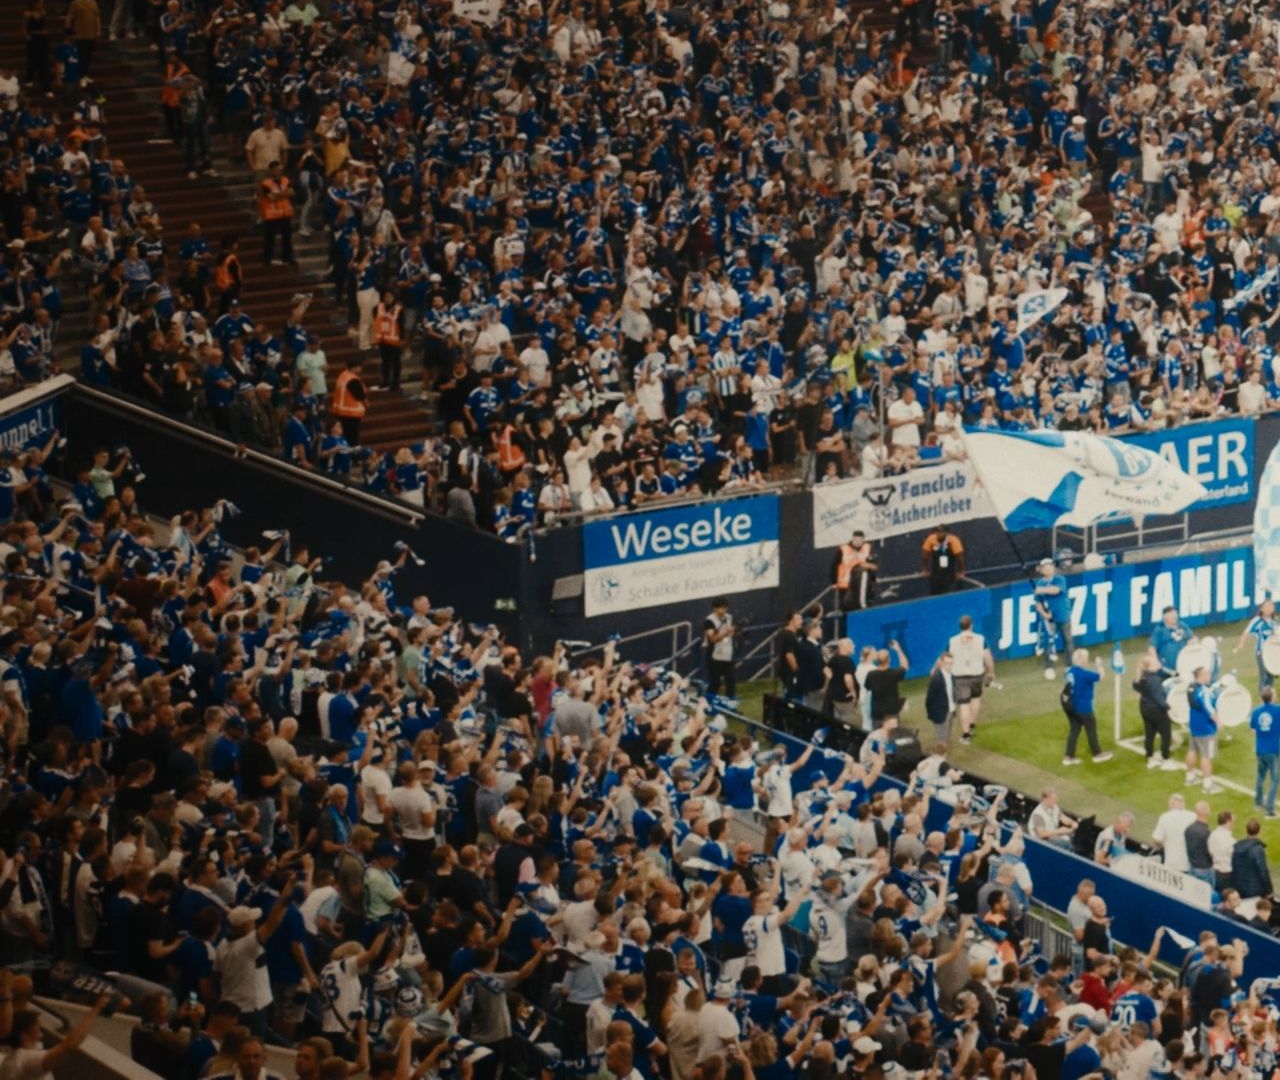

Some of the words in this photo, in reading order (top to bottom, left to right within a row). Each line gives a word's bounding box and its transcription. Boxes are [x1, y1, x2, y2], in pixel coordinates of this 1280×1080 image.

[1159, 430, 1249, 484] AER
[899, 469, 966, 502] Fanclub
[611, 506, 752, 559] Weseke
[629, 580, 680, 603] Schalke
[683, 571, 736, 592] Fanclub
[998, 581, 1113, 651] JEZT
[1146, 863, 1184, 891] VELTINS
